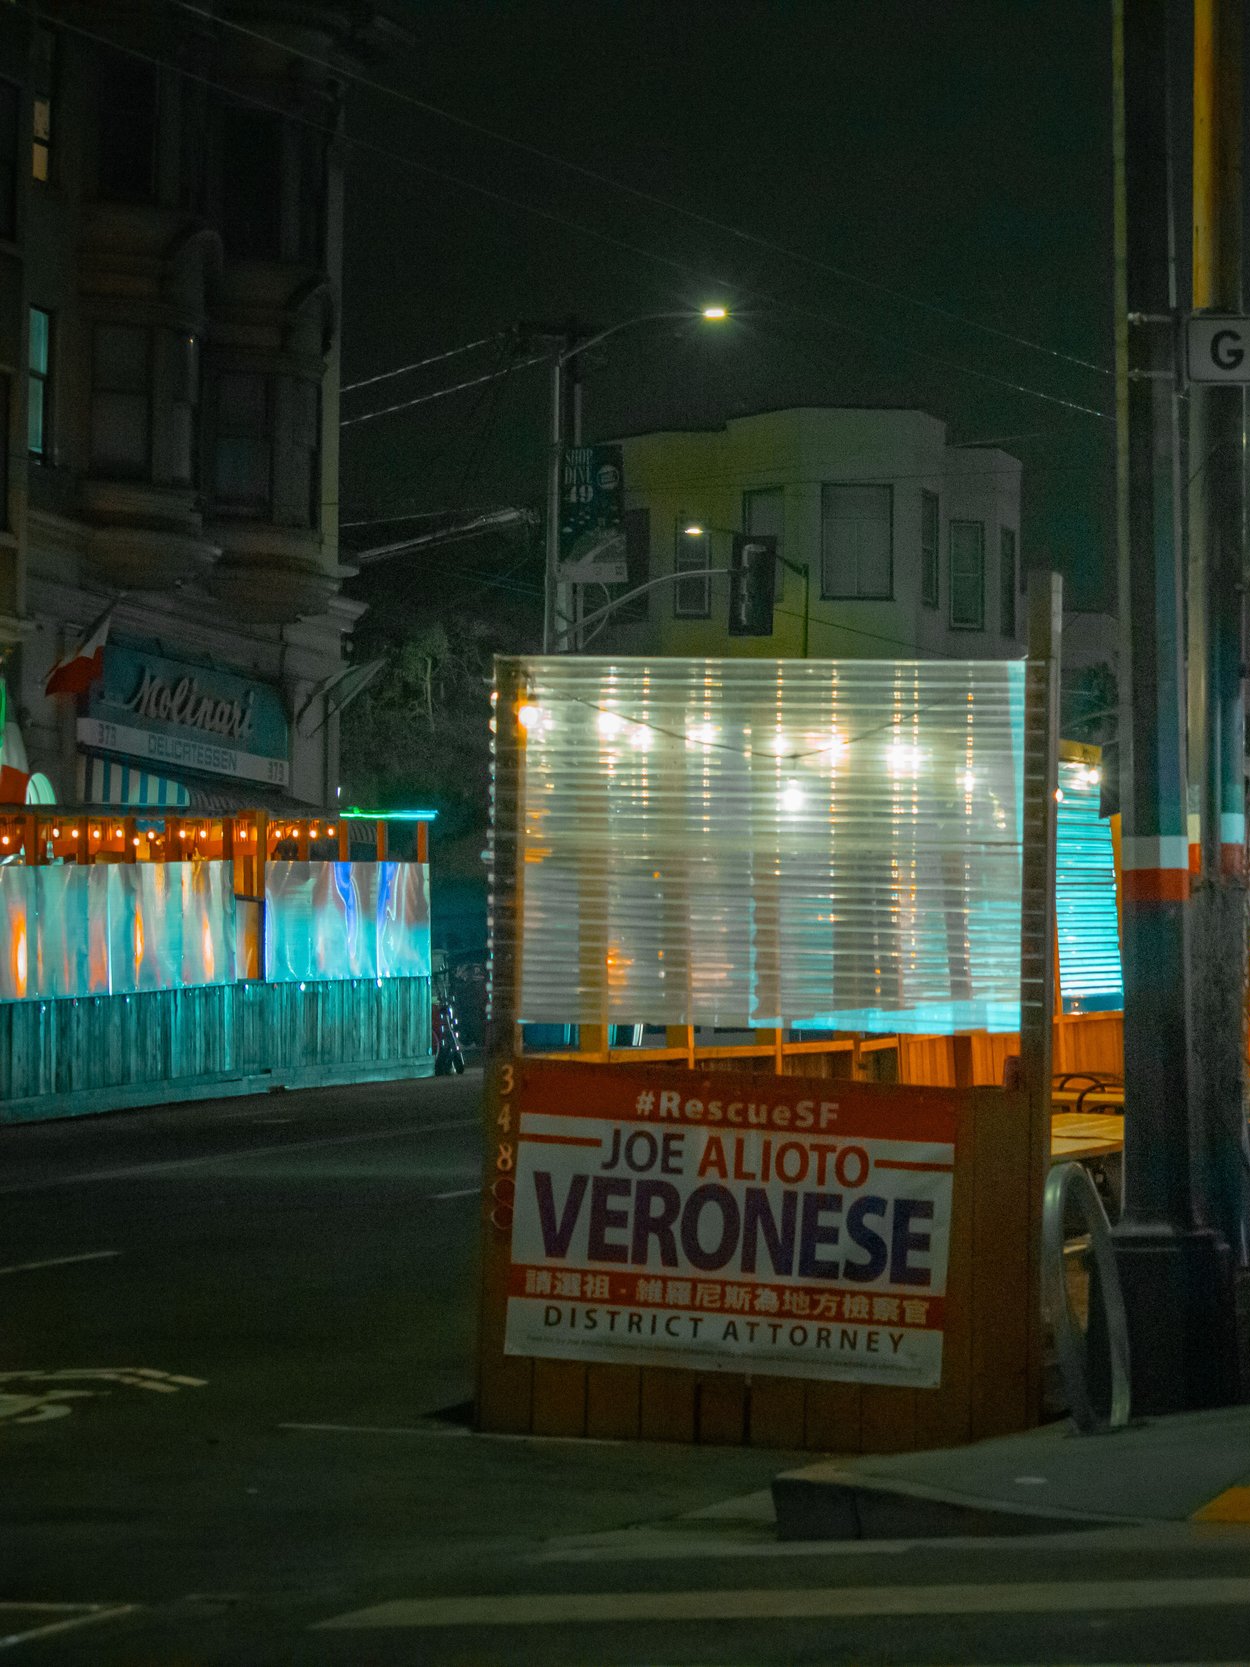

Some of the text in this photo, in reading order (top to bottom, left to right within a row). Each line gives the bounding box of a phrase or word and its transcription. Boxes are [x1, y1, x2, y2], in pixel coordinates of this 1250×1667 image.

[100, 667, 255, 739] Molinari
[148, 733, 239, 772] DELICATESSEN
[635, 1089, 840, 1129] #RescueSF
[601, 1128, 870, 1189] JOE ALIOTO
[533, 1170, 935, 1287] VERONESE
[543, 1305, 904, 1354] DISTRICT ATTORNEY
